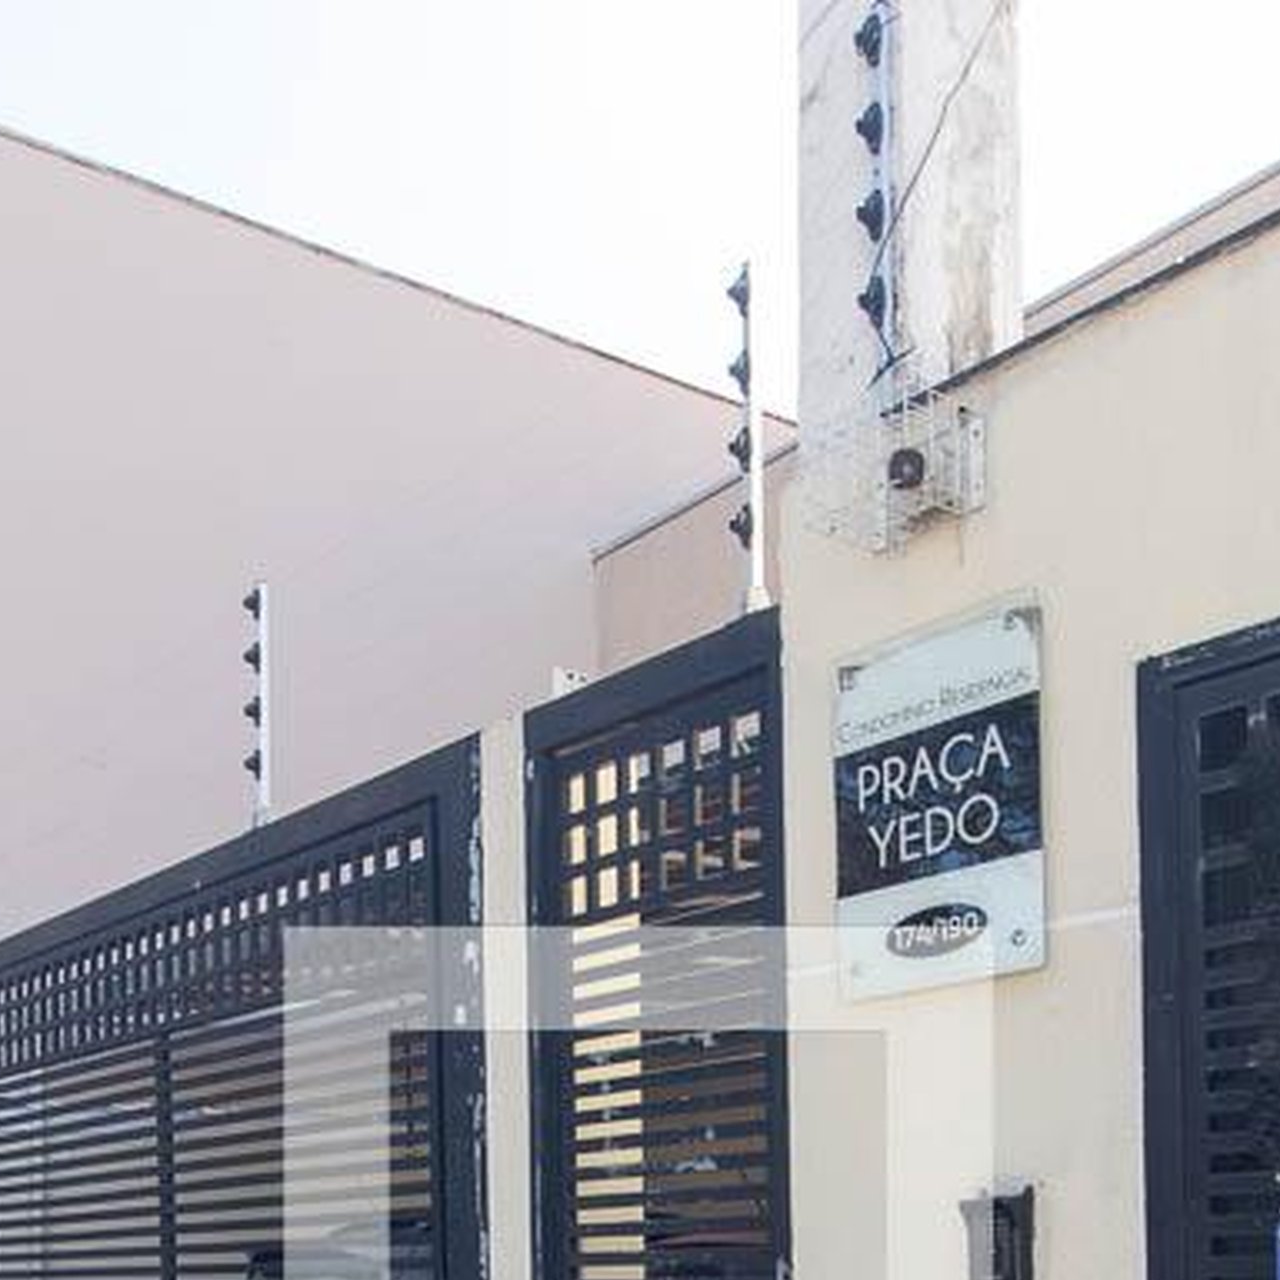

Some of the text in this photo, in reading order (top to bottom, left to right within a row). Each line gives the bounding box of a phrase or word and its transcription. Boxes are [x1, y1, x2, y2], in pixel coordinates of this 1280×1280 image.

[856, 723, 1011, 812] PRAÇA
[868, 793, 1001, 869] YEDO
[894, 910, 980, 951] 174/190
